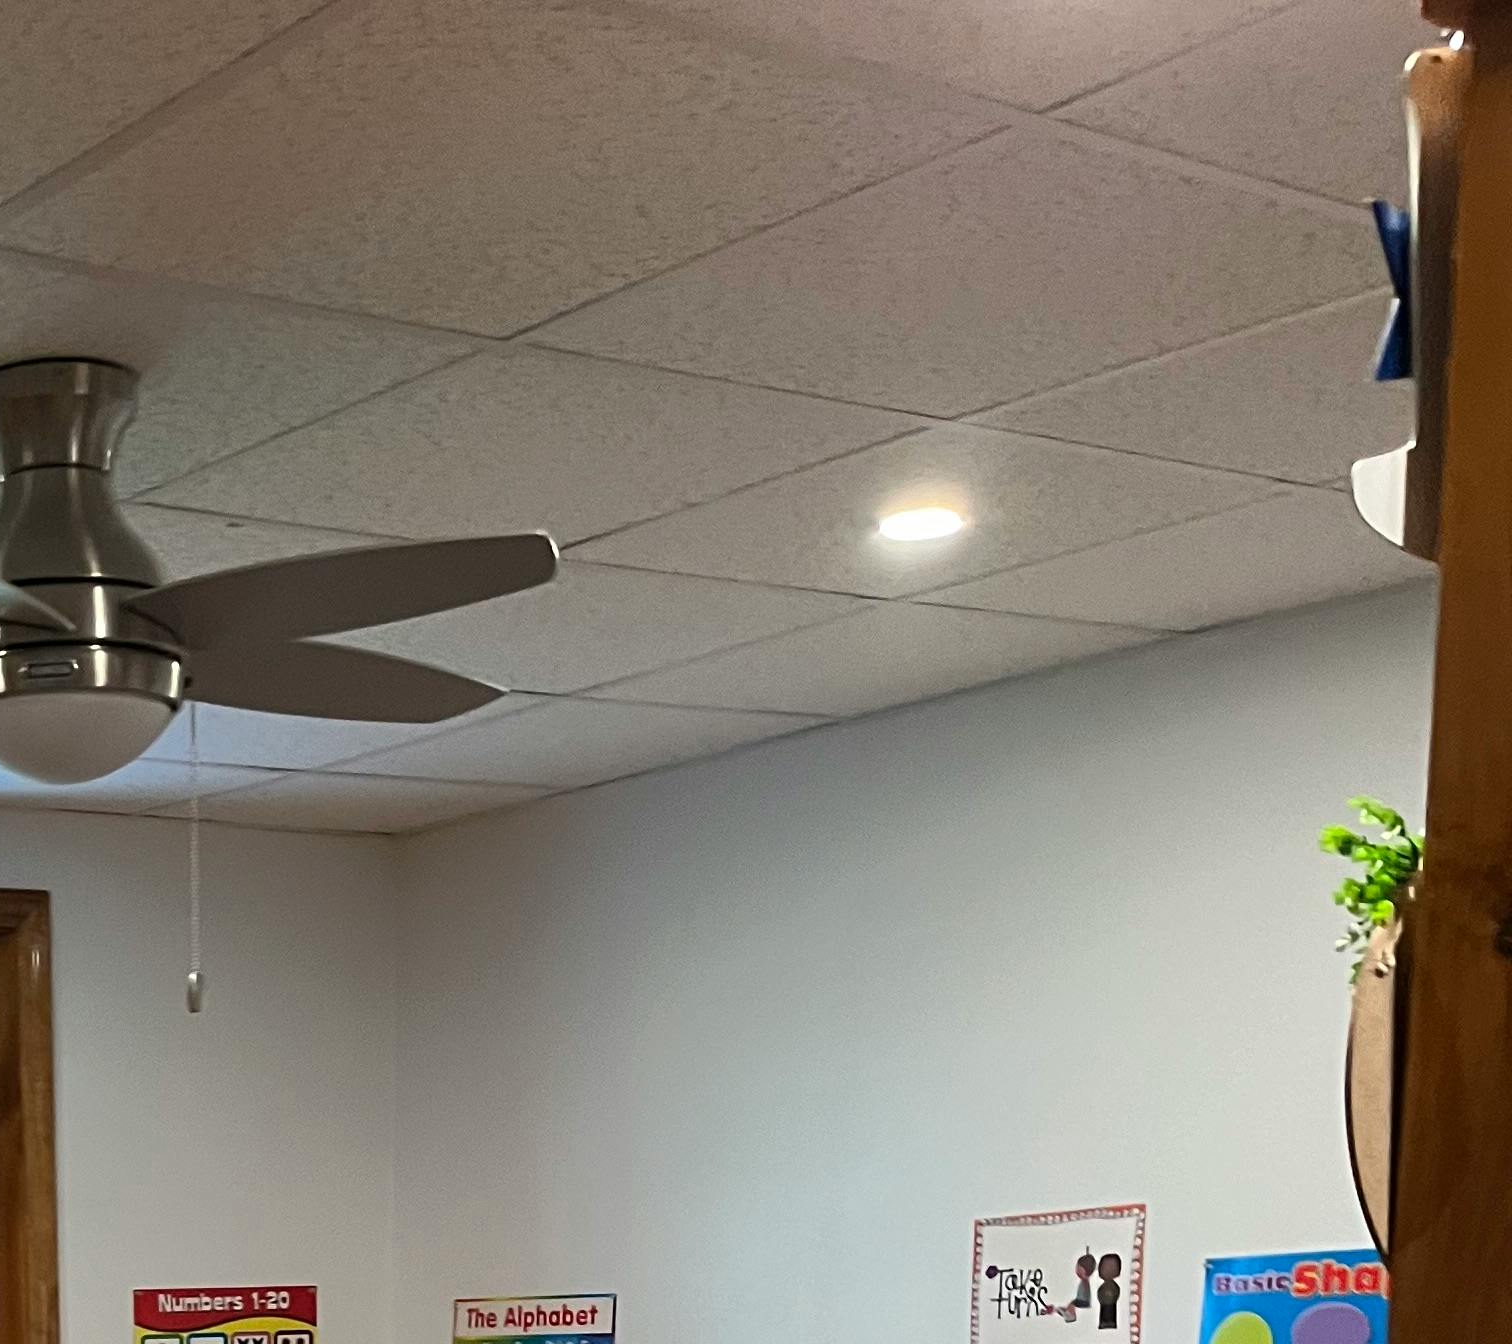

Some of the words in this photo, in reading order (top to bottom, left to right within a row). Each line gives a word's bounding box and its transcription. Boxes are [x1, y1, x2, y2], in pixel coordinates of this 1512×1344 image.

[1215, 1271, 1291, 1296] Basic
[158, 1293, 244, 1313] Numbers
[251, 1290, 291, 1310] 1-20
[466, 1308, 497, 1329] The
[503, 1304, 599, 1332] Alphabet
